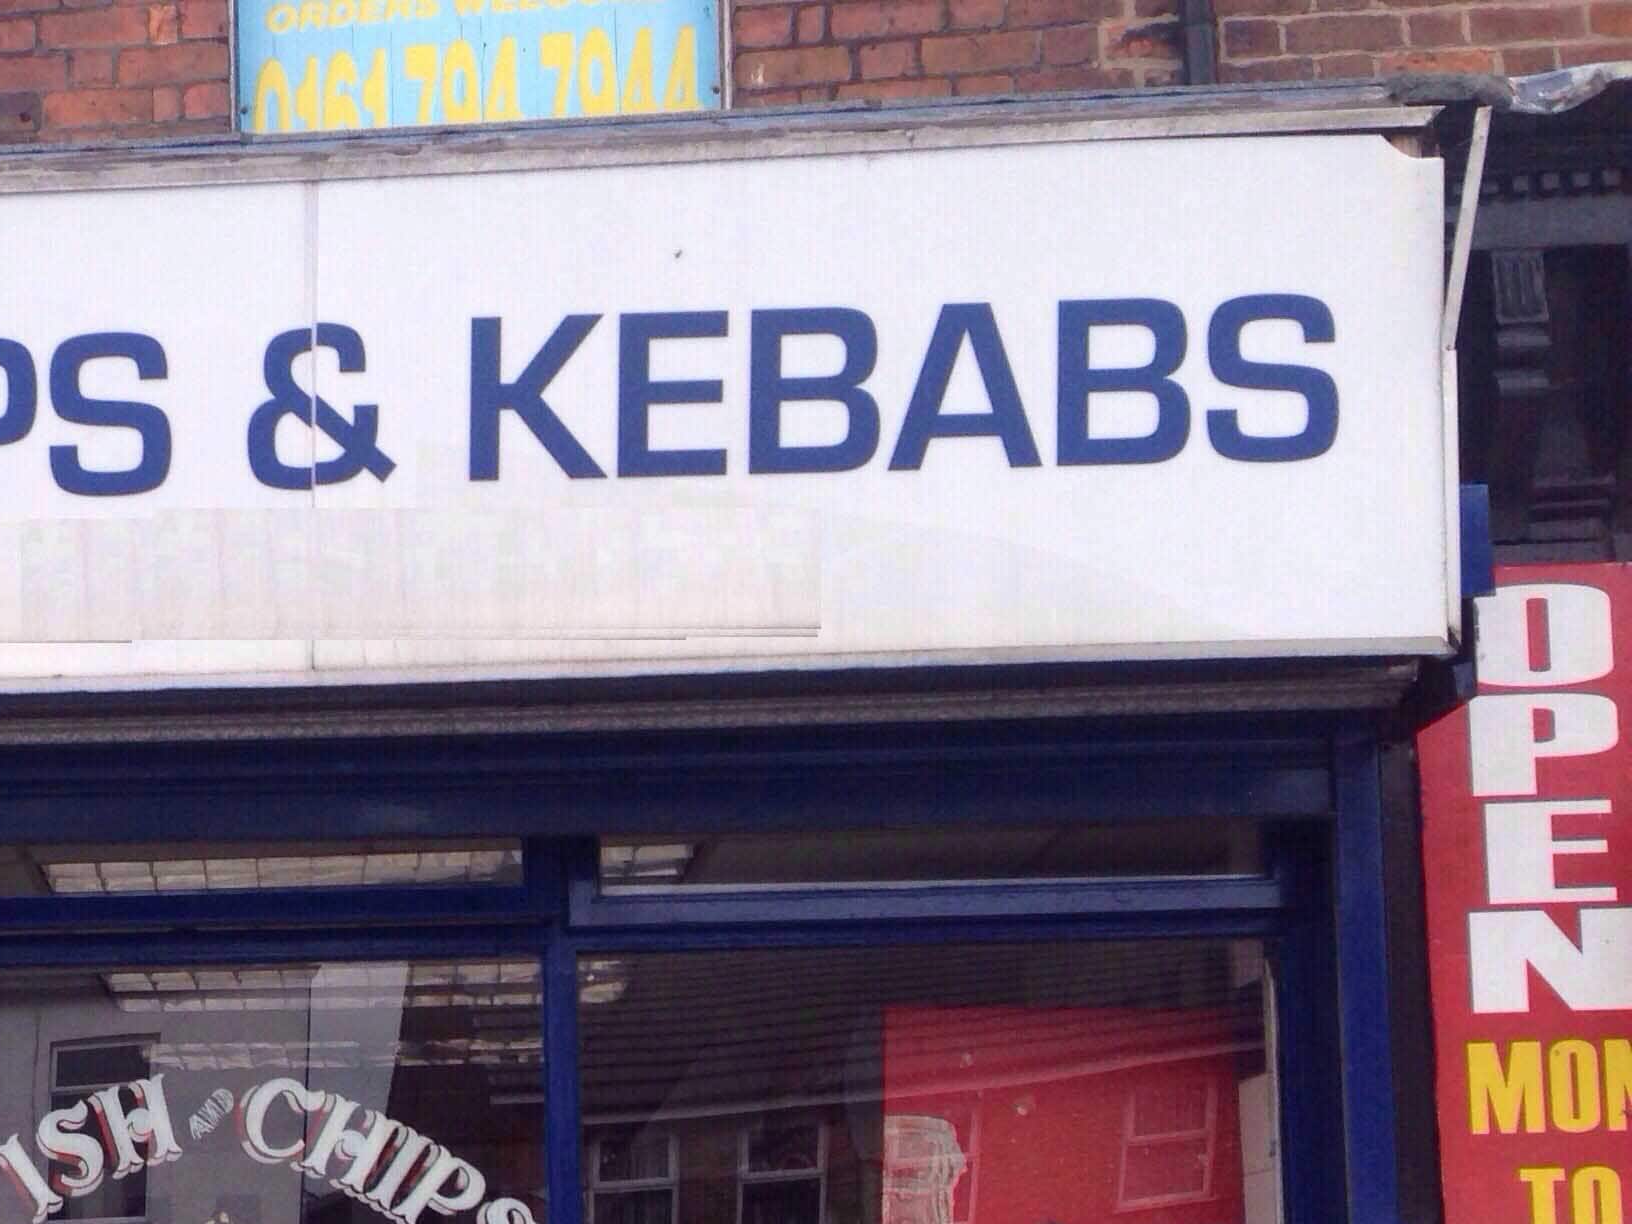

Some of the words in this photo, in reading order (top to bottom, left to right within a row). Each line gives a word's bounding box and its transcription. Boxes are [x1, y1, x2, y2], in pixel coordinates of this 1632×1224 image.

[254, 48, 387, 134] 0161
[246, 322, 398, 491] &
[468, 293, 1341, 483] KEBABS
[1467, 582, 1632, 1013] OPEN
